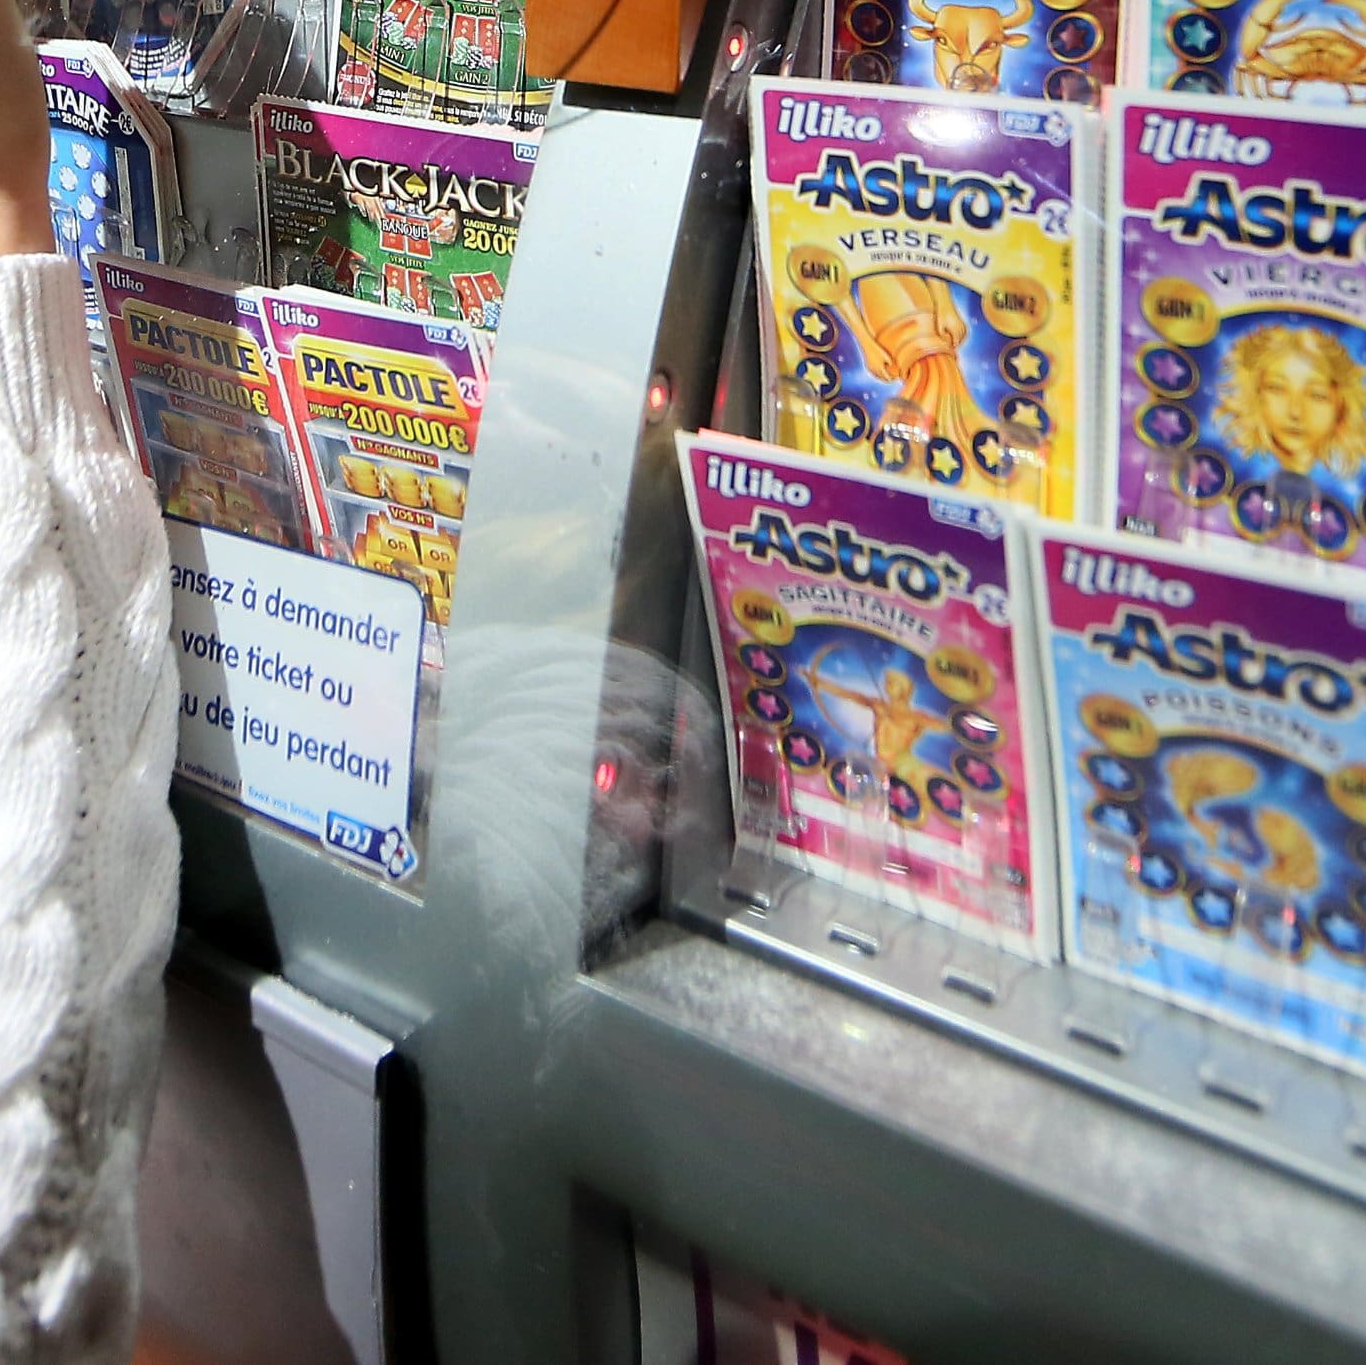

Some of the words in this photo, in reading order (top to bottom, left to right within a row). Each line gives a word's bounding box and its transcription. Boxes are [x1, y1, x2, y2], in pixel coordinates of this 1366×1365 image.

[67, 58, 82, 71] FDJ
[454, 70, 482, 84] GAIN
[271, 109, 314, 134] illiko
[777, 97, 883, 142] illiko
[1139, 112, 1272, 166] illiko
[517, 143, 538, 159] FDJ
[275, 138, 412, 202] BLACK
[424, 163, 528, 220] JACK
[798, 153, 1005, 229] Astro
[381, 217, 428, 239] BANQUE
[463, 218, 497, 233] GAGNEZ
[463, 227, 488, 252] 20
[838, 228, 992, 270] VERSEAU
[105, 266, 145, 293] illiko
[238, 299, 255, 313] FDJ
[271, 302, 320, 328] illiko
[129, 313, 261, 377] PACTOLE
[302, 352, 457, 410] PACTOLE
[343, 402, 394, 438] 200
[373, 444, 436, 466] GAGNANTS
[707, 454, 812, 508] illiko
[390, 507, 415, 523] VOS
[387, 536, 408, 552] OR
[430, 548, 451, 564] OR
[733, 512, 941, 601] Astro
[1062, 546, 1196, 608] illiko
[241, 578, 257, 612] à
[264, 586, 402, 655] demander
[778, 585, 935, 643] SAGITTAIRE
[181, 629, 240, 669] votre
[246, 644, 315, 694] ticket
[319, 676, 354, 708] ou
[1091, 611, 1356, 714] Astro
[204, 695, 236, 732] de
[240, 705, 280, 746] jeu
[286, 730, 393, 789] perdant
[1142, 690, 1342, 757] POISSONS
[330, 818, 372, 854] FDJ
